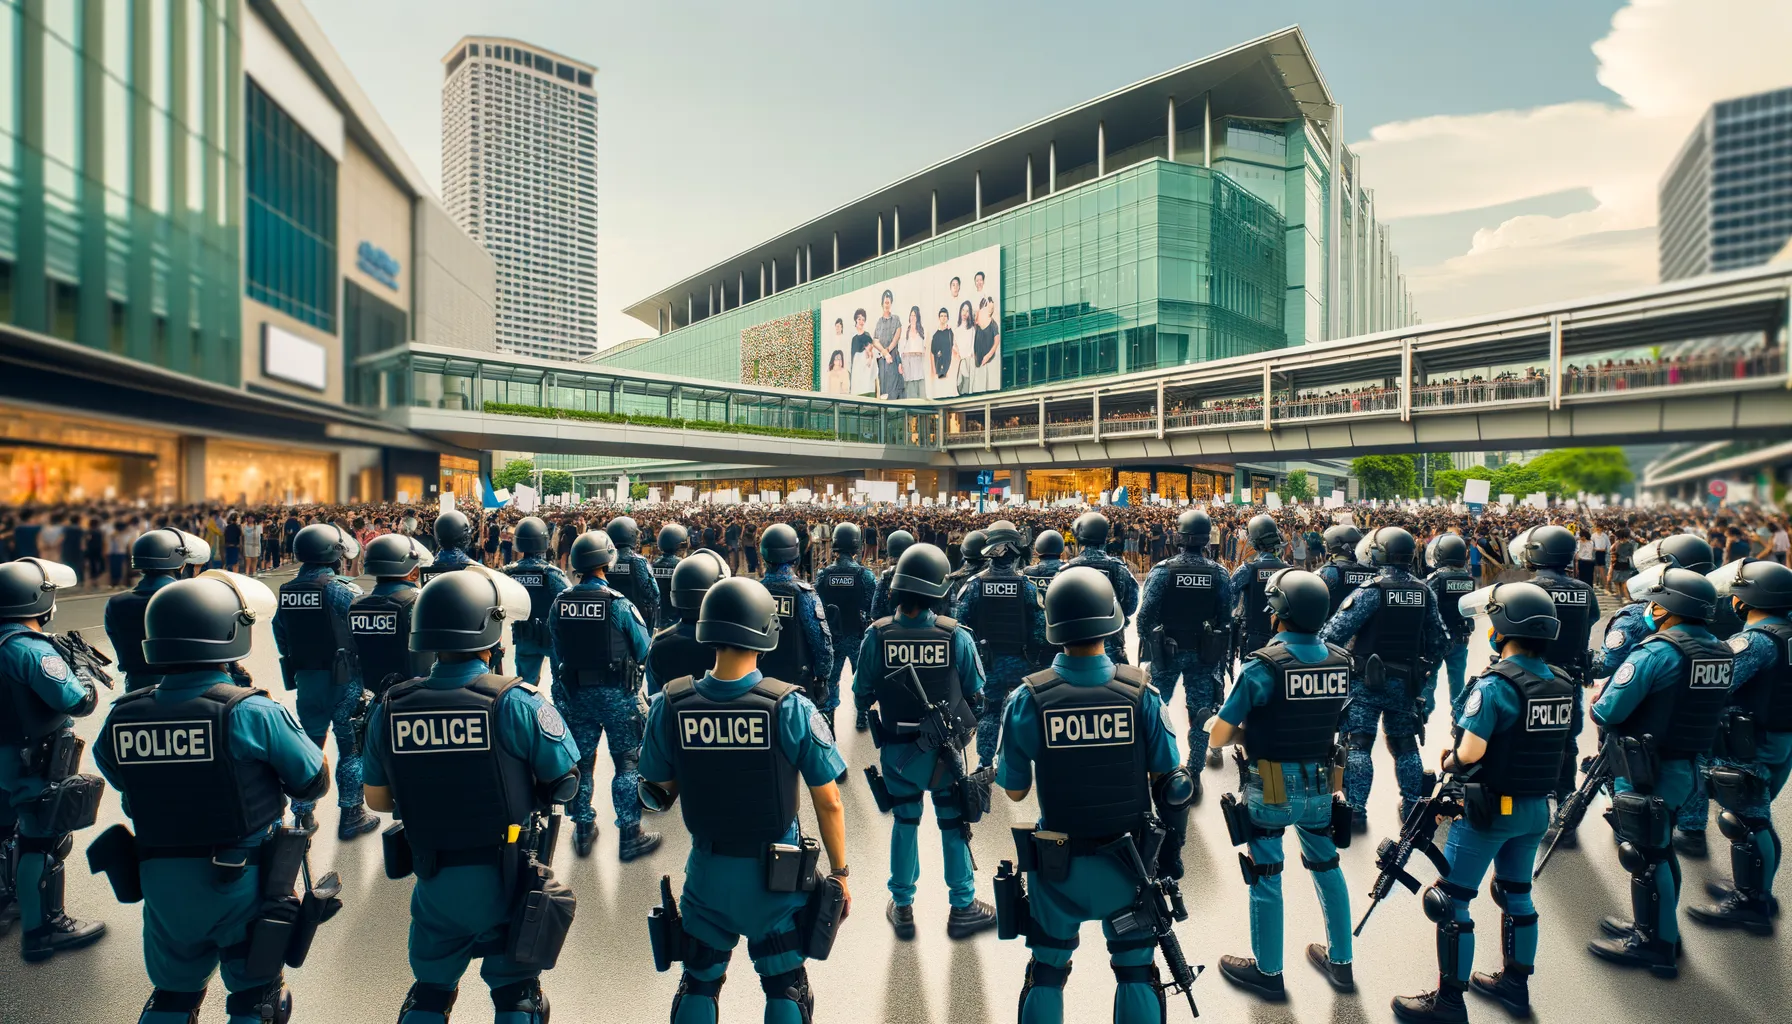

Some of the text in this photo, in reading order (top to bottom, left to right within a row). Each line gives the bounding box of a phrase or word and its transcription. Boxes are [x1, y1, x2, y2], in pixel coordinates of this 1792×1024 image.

[888, 644, 945, 664] POLICE
[1290, 672, 1347, 696] POLICE
[1050, 712, 1130, 742] POLICE
[1529, 702, 1572, 726] POLIC
[119, 728, 205, 758] POLICE
[396, 717, 483, 747] POLICE
[684, 717, 764, 744] POLICE
